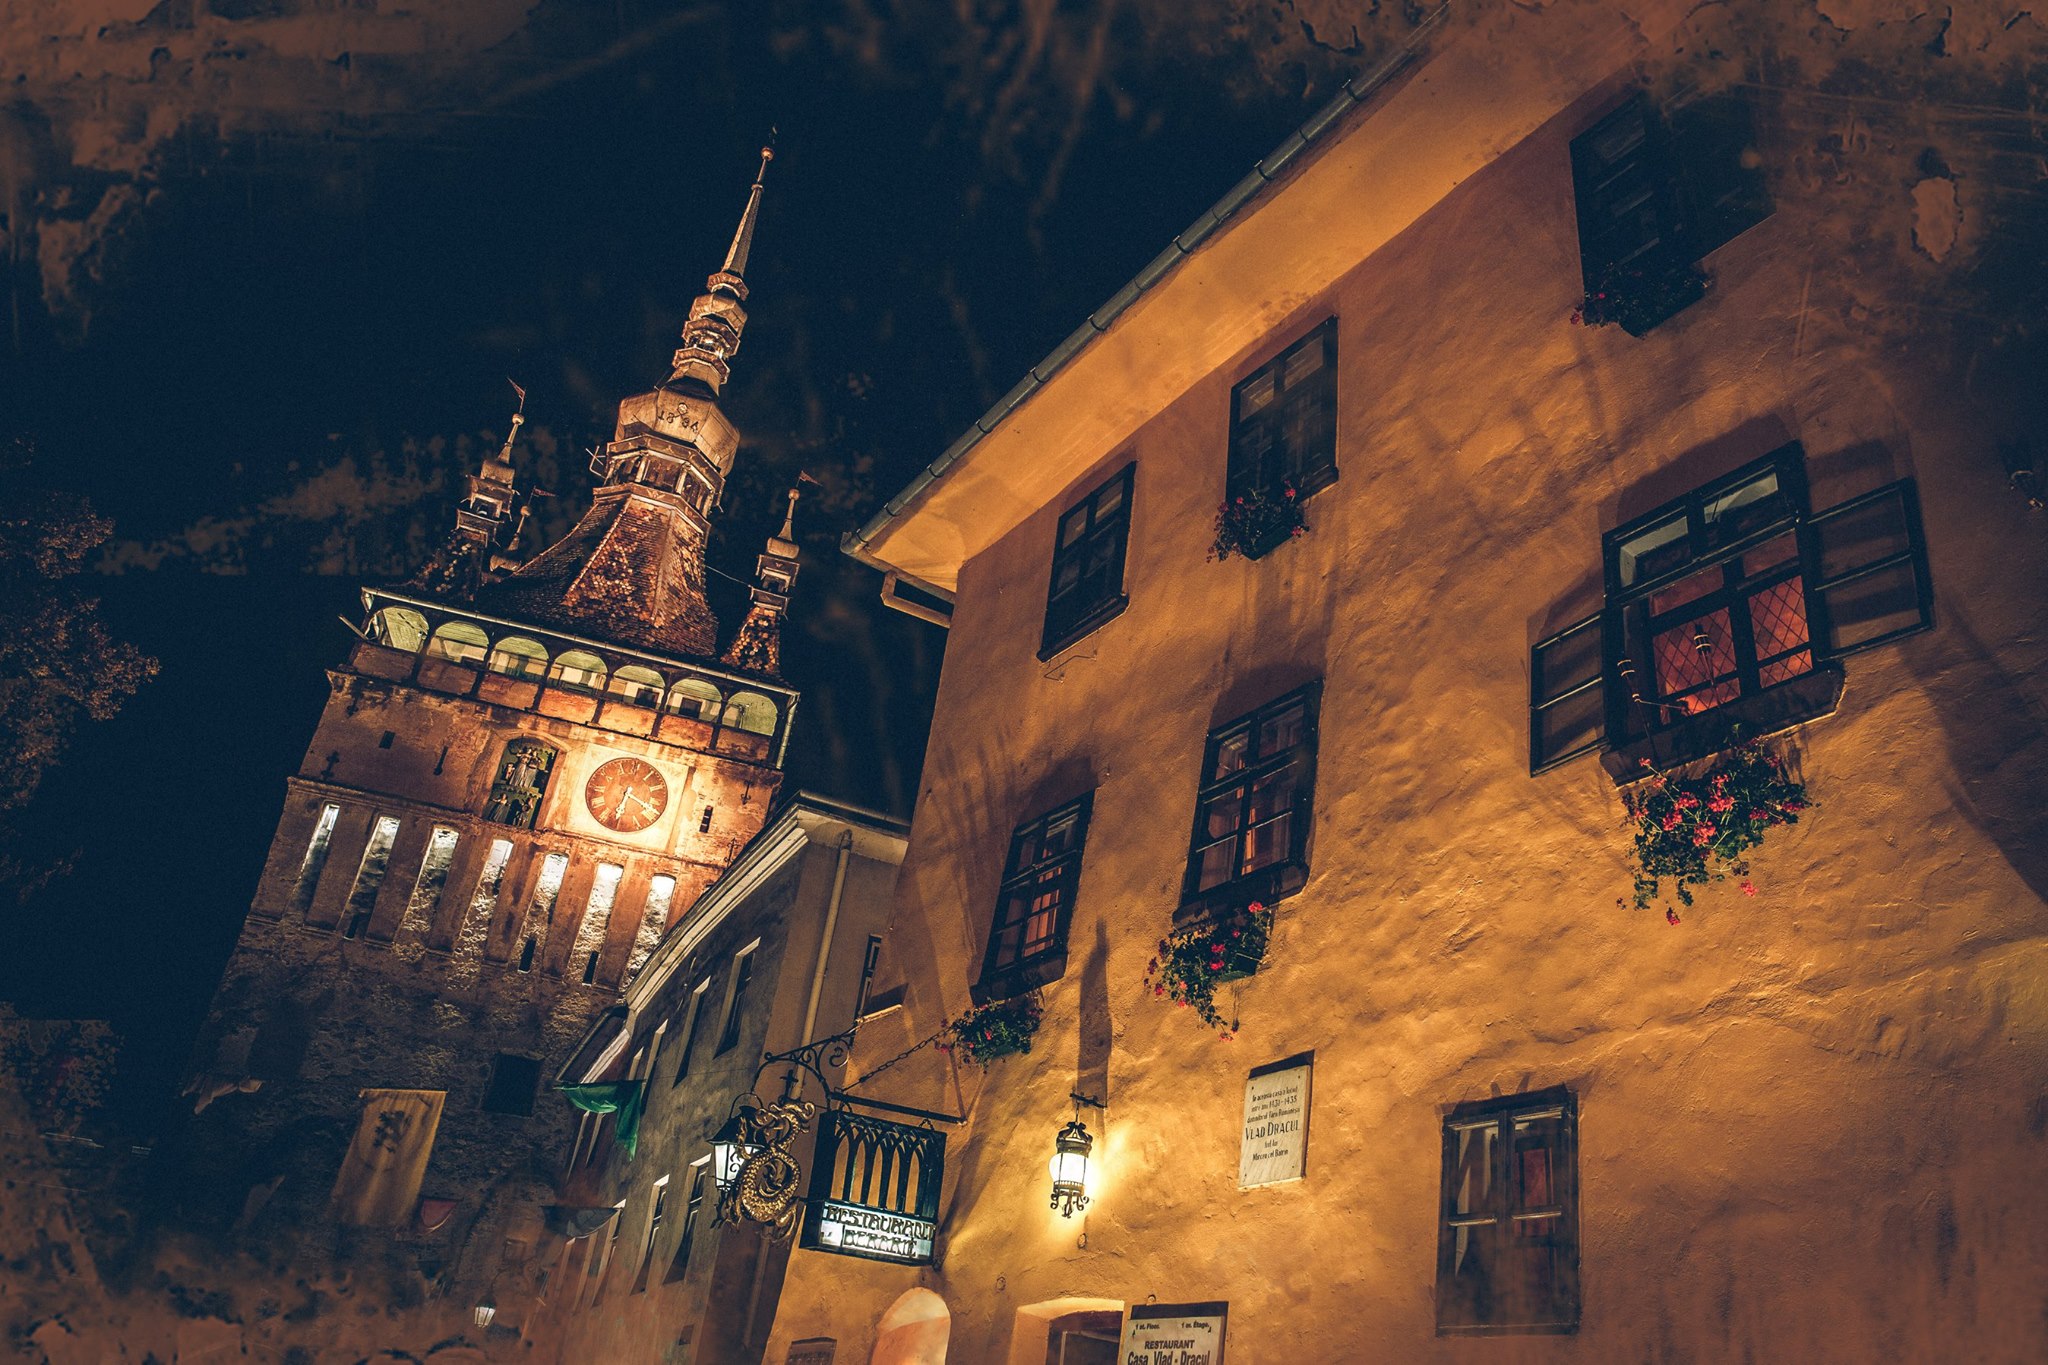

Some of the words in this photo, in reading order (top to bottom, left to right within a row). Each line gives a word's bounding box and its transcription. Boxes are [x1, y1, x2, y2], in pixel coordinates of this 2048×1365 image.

[1245, 1126, 1266, 1140] VLAD
[1267, 1120, 1300, 1137] DRACUL
[826, 1204, 936, 1241] RESTAURANT
[1144, 1340, 1195, 1350] RESTAURANT
[1127, 1351, 1149, 1365] Casa
[1153, 1350, 1173, 1365] Vlad
[1180, 1350, 1211, 1365] Dracul
